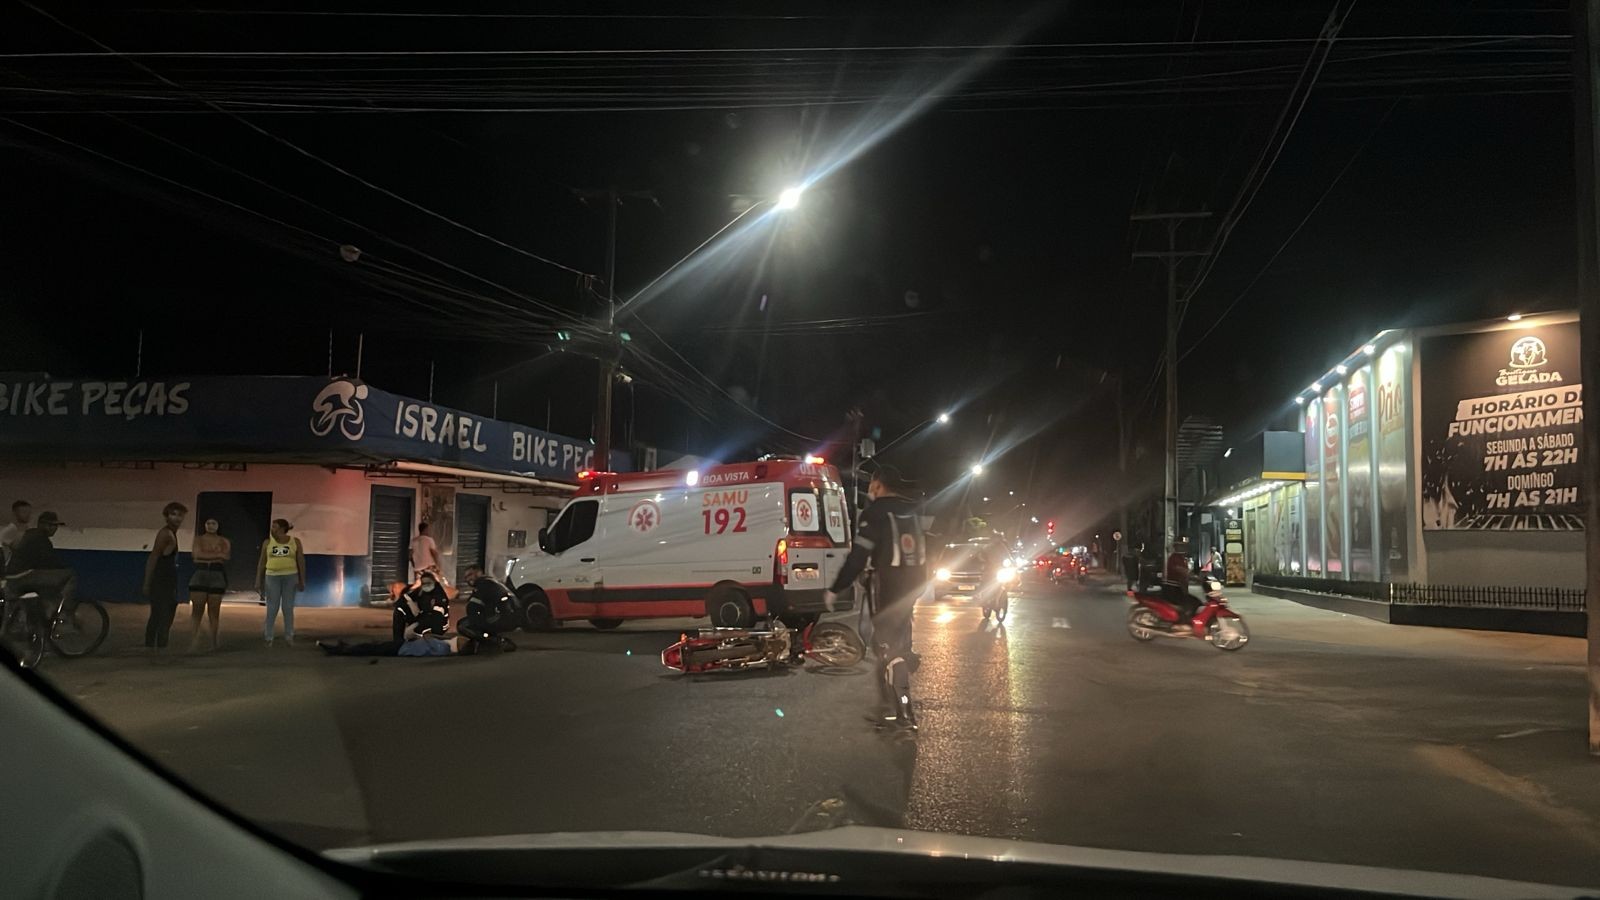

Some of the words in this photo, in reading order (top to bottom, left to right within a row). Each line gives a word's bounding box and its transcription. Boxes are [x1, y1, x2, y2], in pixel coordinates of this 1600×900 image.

[1495, 371, 1563, 386] GELADA
[81, 382, 191, 420] PEÇAS
[1471, 394, 1558, 416] HORÁRIO
[1564, 391, 1582, 404] D
[395, 401, 487, 452] ISRAEL
[512, 431, 558, 468] BIKE
[1486, 438, 1528, 455] SEGUNDA
[1529, 437, 1536, 450] A
[1537, 432, 1574, 449] SÁBADO
[1483, 455, 1508, 472] 7H
[1542, 448, 1578, 466] 22H
[703, 474, 723, 484] BOA
[724, 472, 749, 482] VISTA
[1507, 472, 1554, 490] DOMINGO
[702, 489, 748, 507] SAMU
[1486, 492, 1511, 509] 7H
[1545, 487, 1578, 505] 21H
[702, 506, 748, 535] 192
